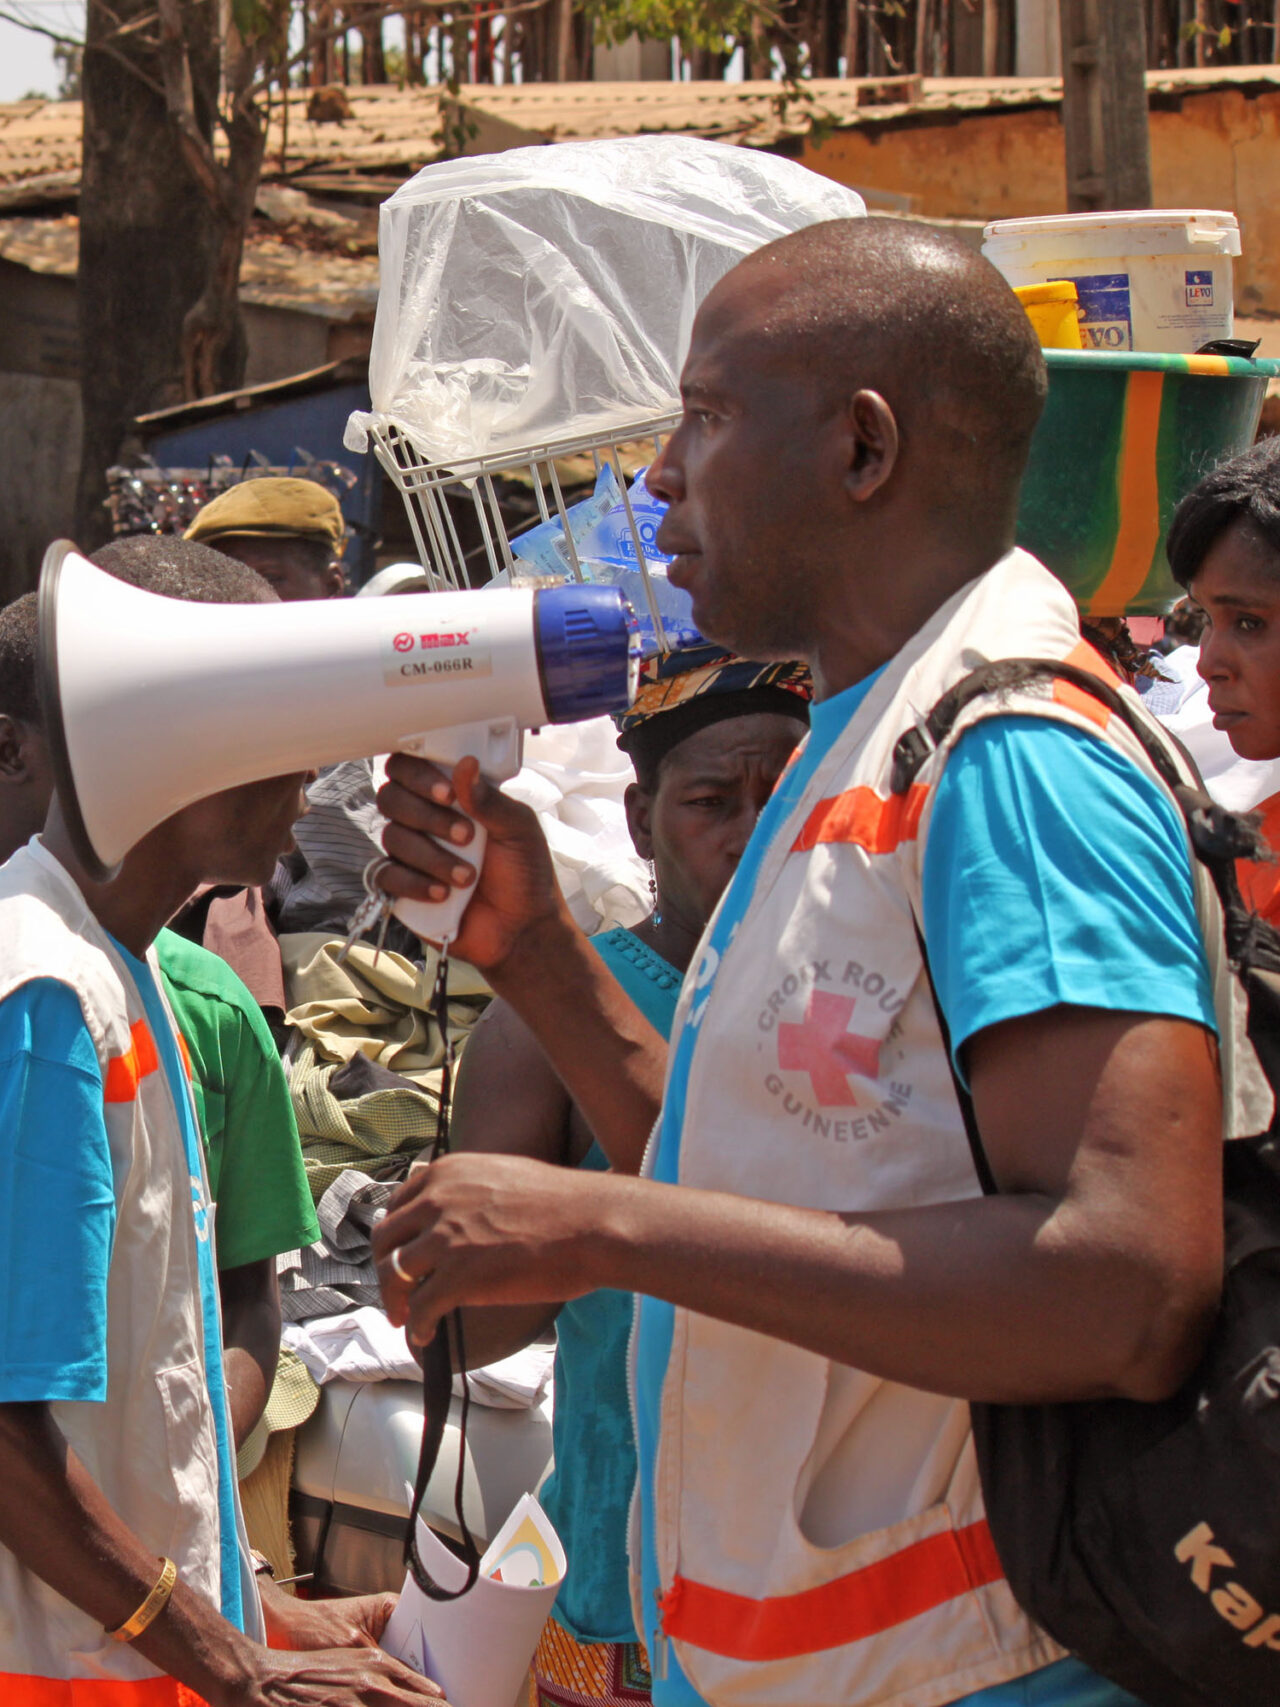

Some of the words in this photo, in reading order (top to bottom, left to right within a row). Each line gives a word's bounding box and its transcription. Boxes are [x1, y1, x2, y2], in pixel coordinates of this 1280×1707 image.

[1189, 287, 1211, 298] LEVO
[400, 657, 473, 677] CM-066R
[758, 960, 832, 1033] CROIX
[842, 960, 906, 1044] ROUE
[764, 1081, 913, 1143] GUINEENNE
